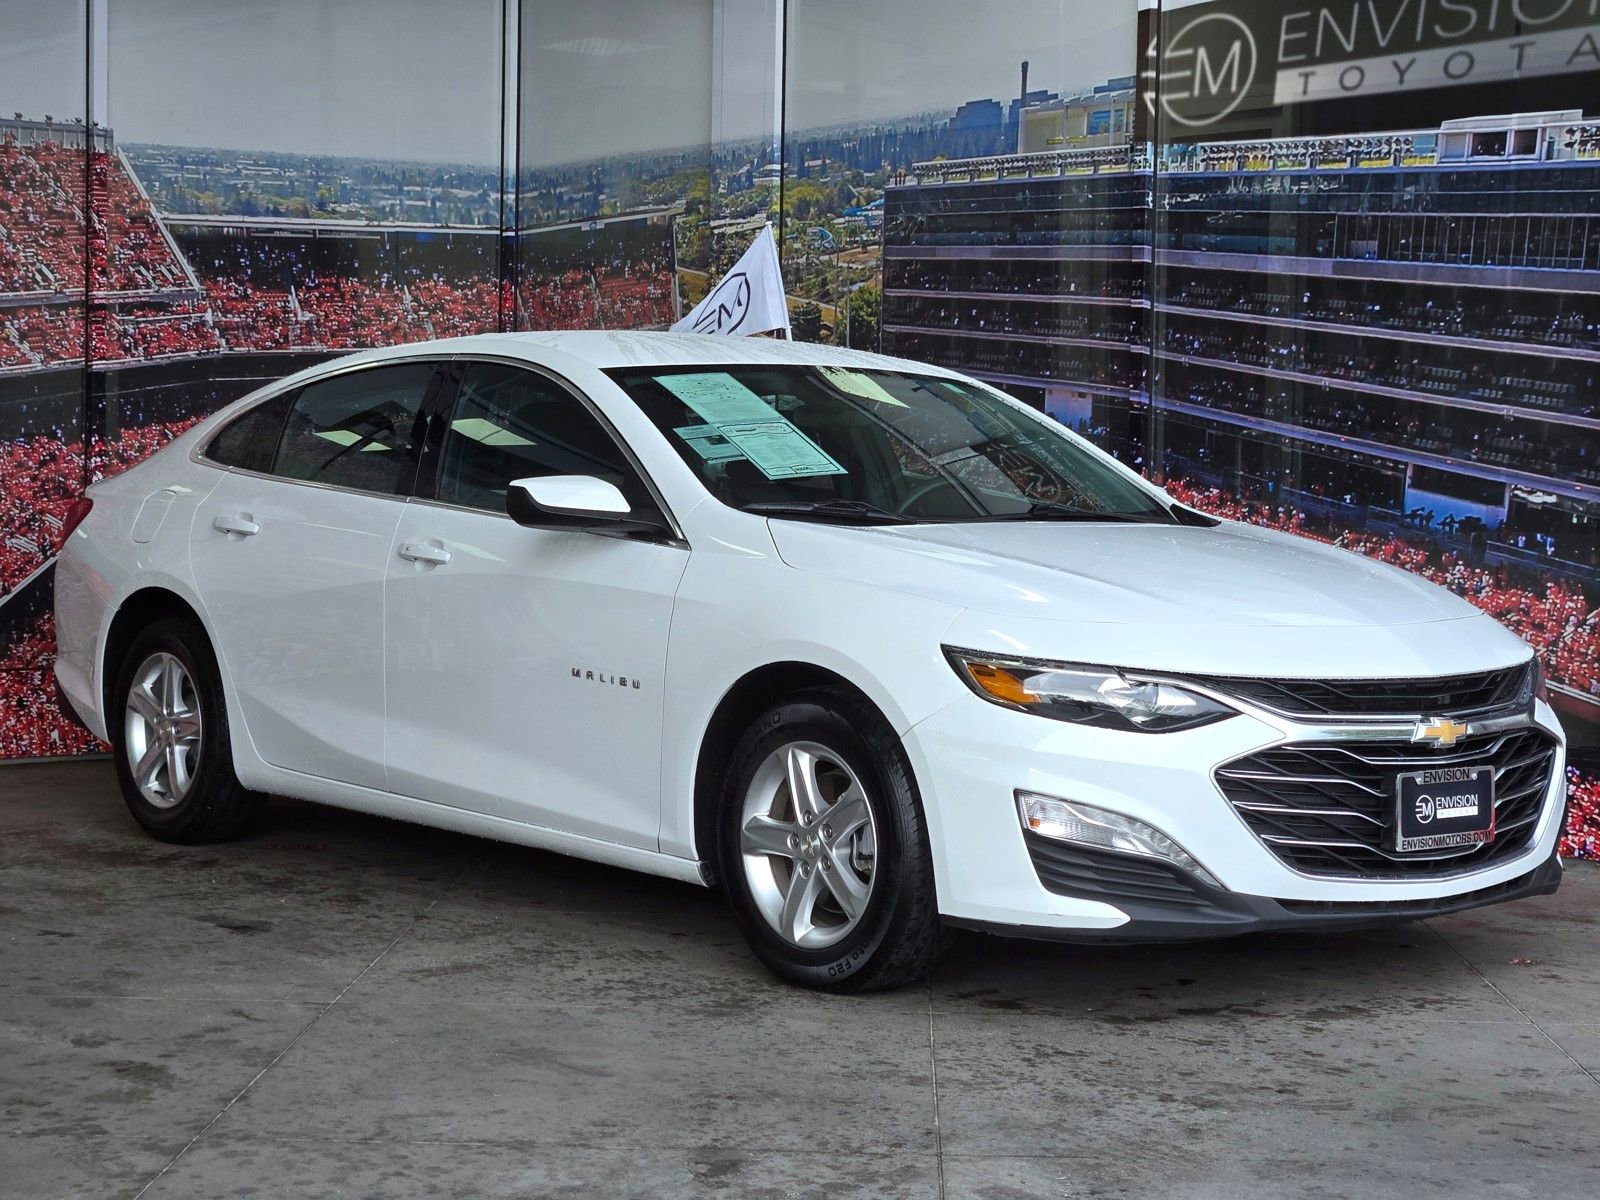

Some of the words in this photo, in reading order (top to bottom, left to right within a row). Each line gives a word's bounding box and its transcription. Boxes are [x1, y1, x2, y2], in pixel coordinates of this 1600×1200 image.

[1298, 33, 1600, 96] TOYOTA
[571, 667, 640, 689] MALIBU
[1423, 768, 1470, 783] ENVISION
[1436, 794, 1478, 809] ENVISION
[1402, 831, 1491, 851] ENVISIONMOTORS.COM
